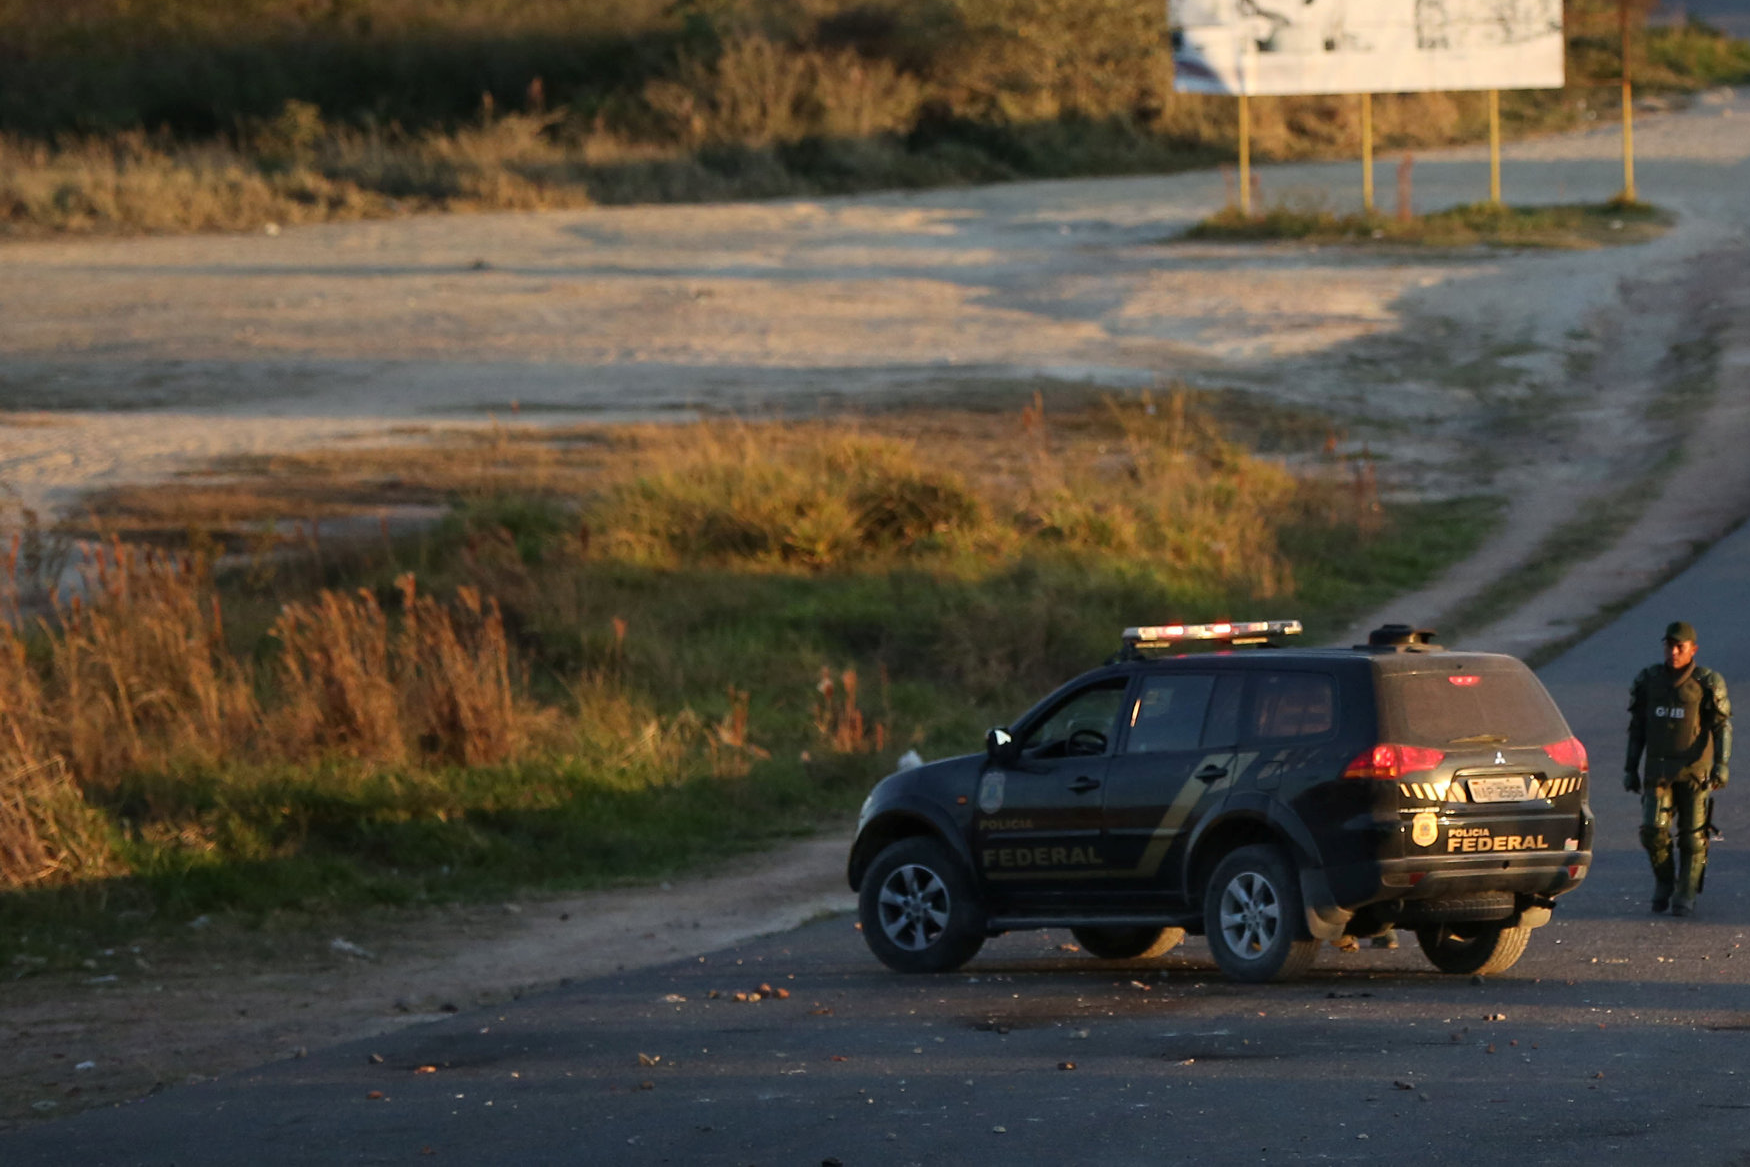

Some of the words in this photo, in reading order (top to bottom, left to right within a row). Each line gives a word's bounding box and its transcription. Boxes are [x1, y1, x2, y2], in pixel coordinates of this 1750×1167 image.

[980, 819, 1033, 830] POLICIA
[1448, 828, 1490, 838] POLICIA
[1447, 835, 1549, 852] FEDERAL
[983, 846, 1104, 867] FEDERAL
